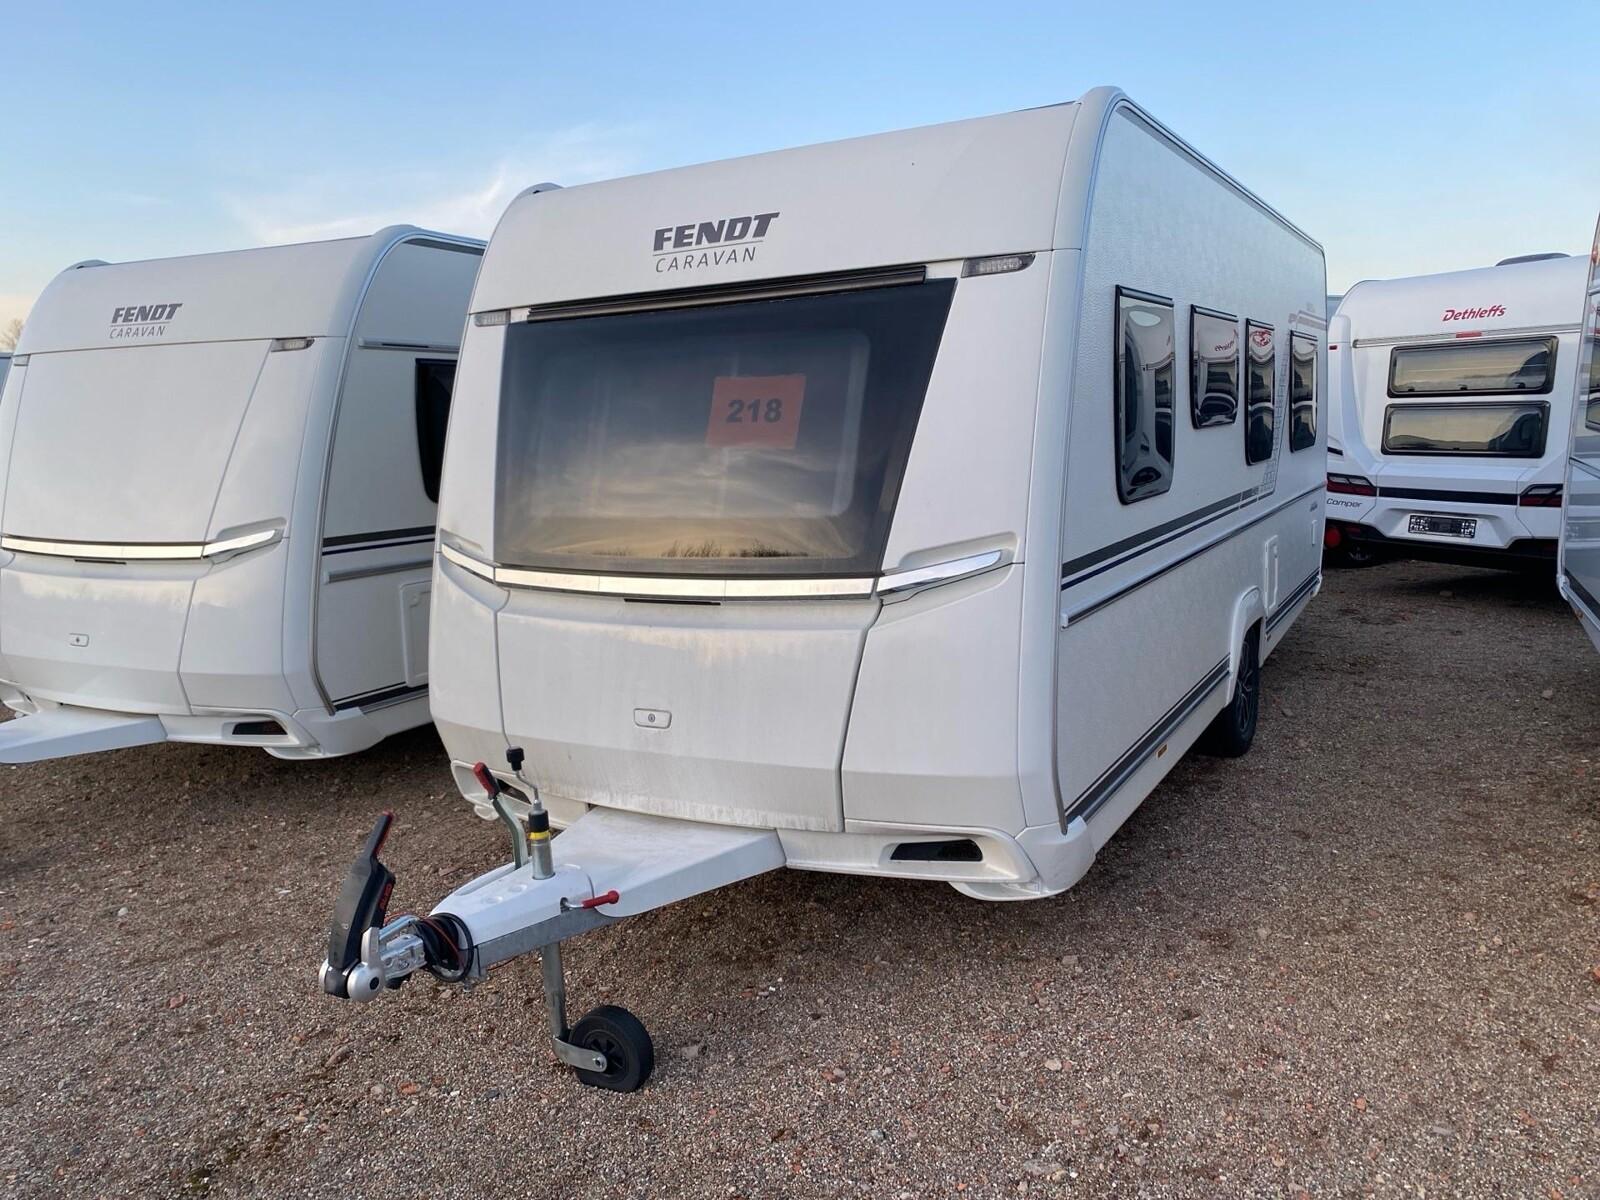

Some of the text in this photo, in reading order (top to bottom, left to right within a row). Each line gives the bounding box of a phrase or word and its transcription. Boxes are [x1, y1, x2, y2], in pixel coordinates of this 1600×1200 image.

[653, 212, 780, 252] FENDT
[655, 247, 756, 273] CARAVAN
[111, 302, 183, 324] FENDT
[1442, 304, 1507, 321] Dethleffs
[109, 325, 166, 339] CARAVAN
[726, 398, 783, 423] 218
